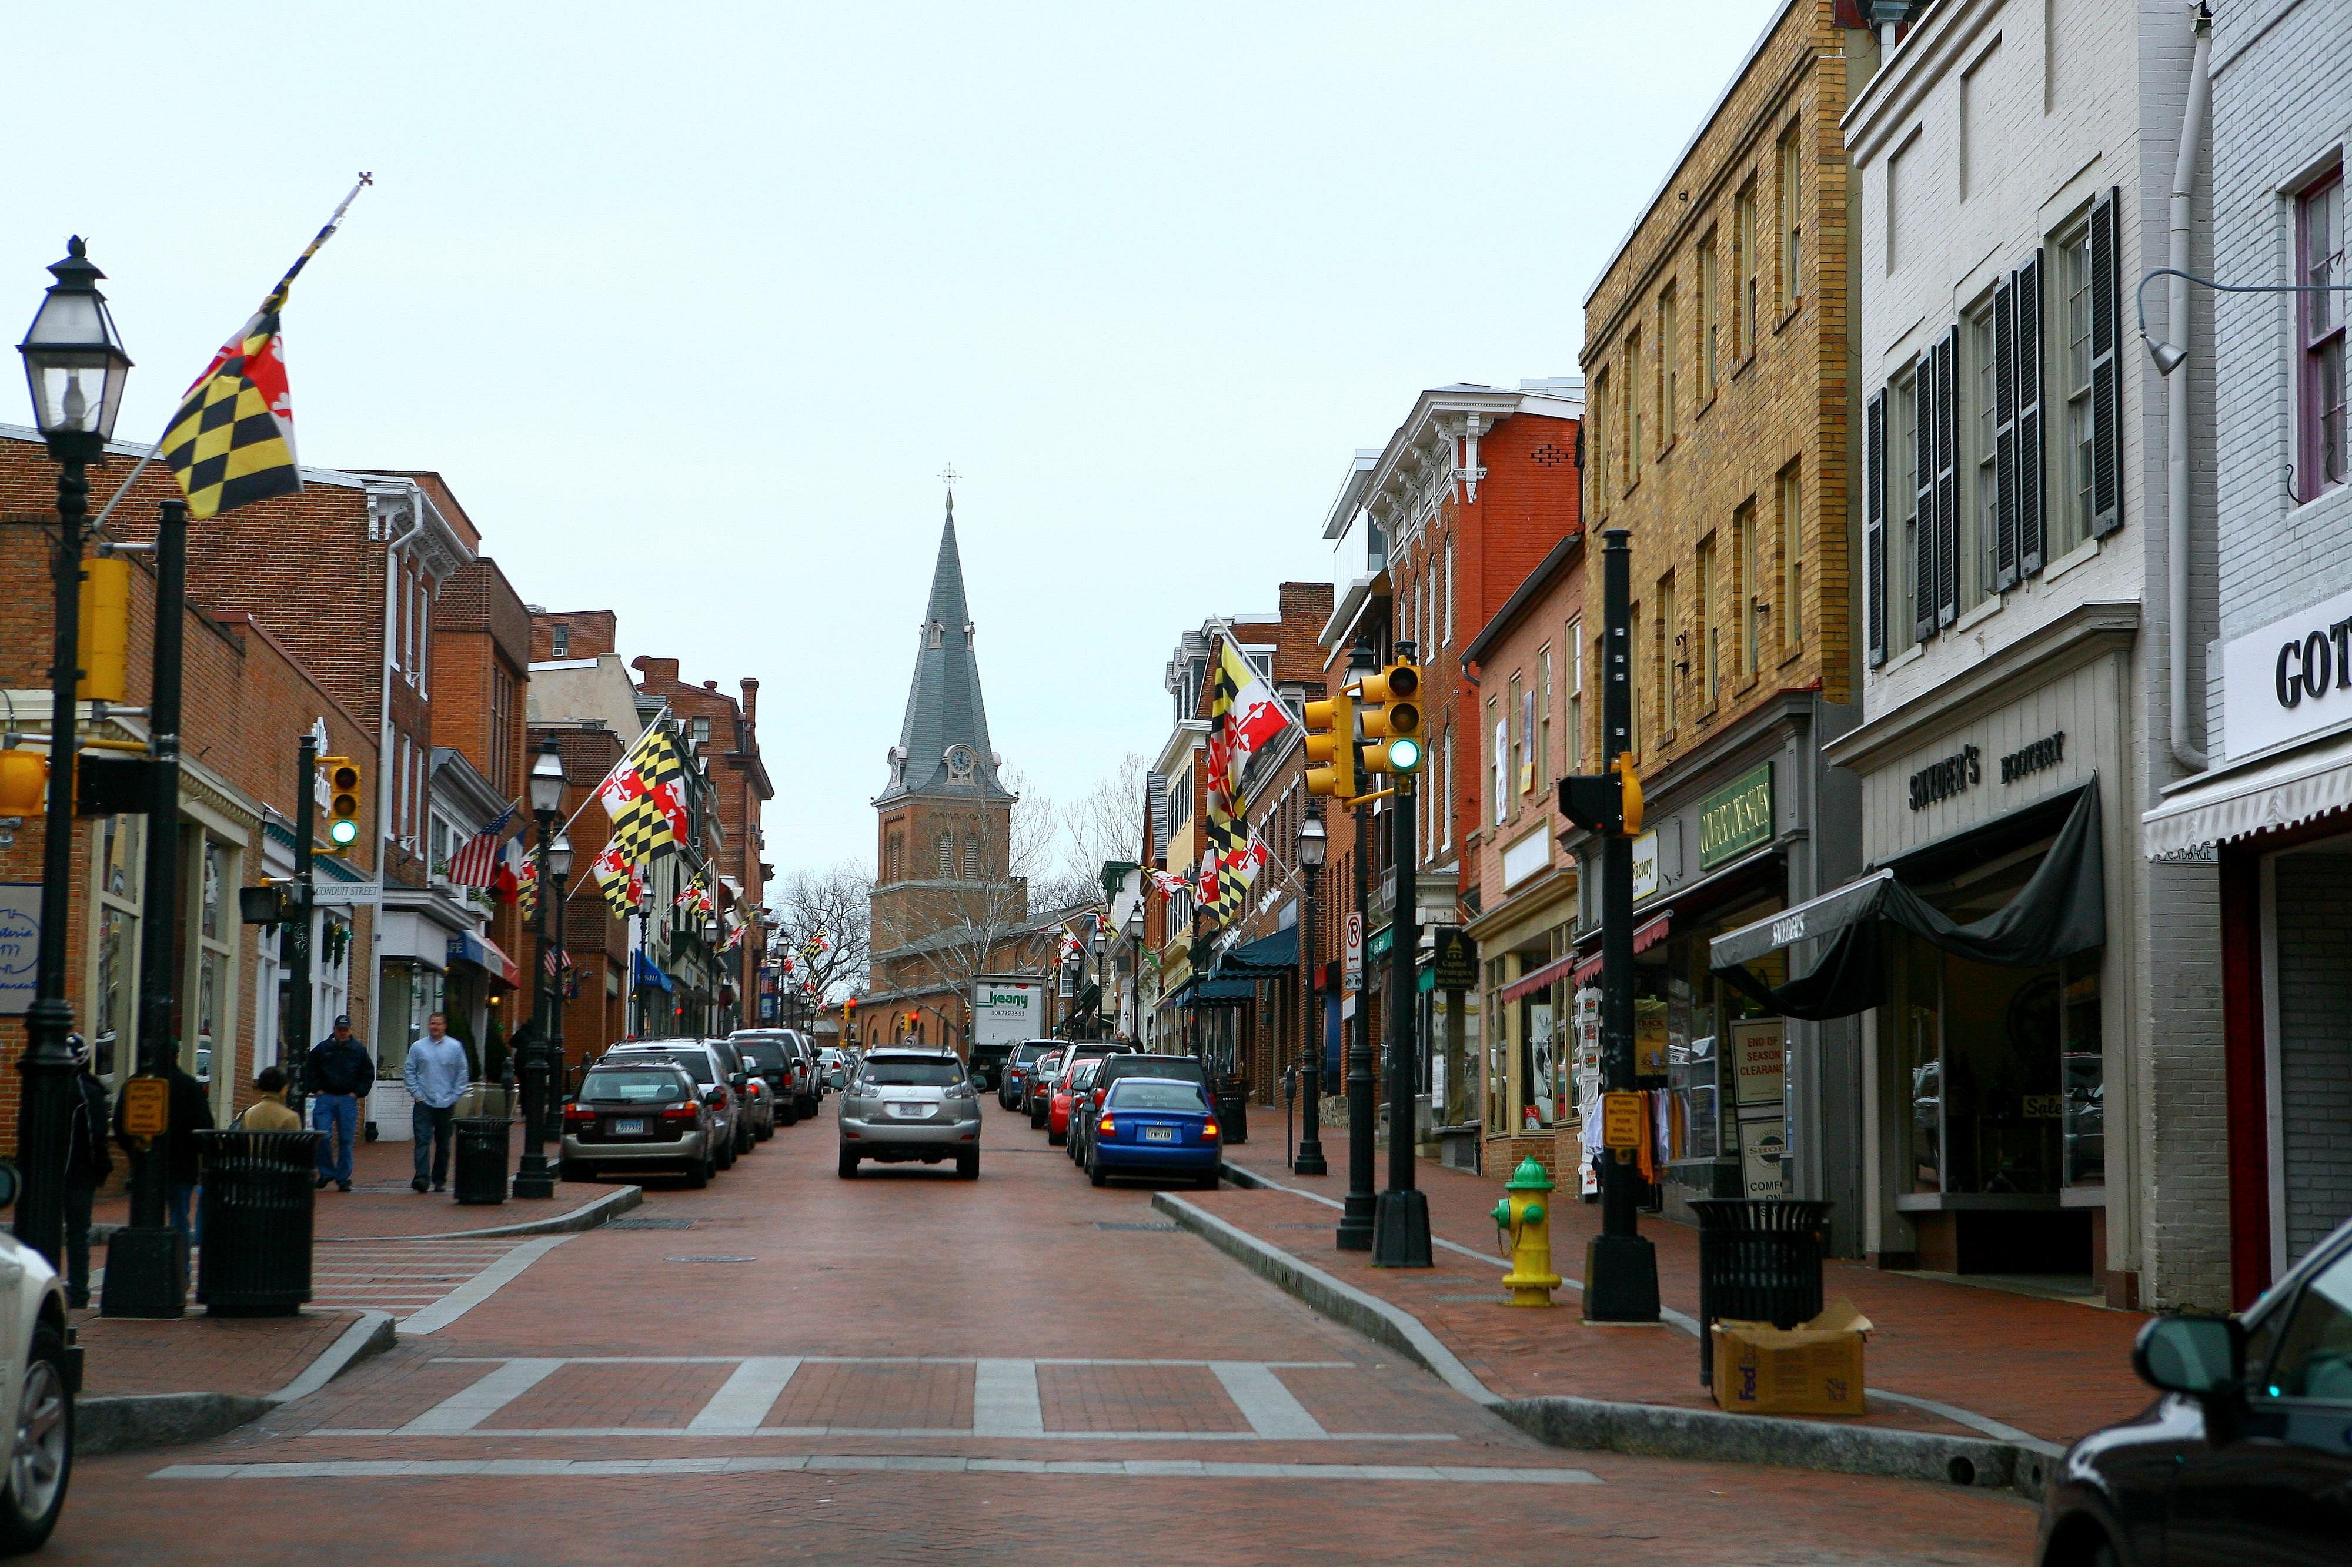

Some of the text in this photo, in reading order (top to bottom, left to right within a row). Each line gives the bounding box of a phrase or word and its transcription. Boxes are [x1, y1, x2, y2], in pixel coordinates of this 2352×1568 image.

[2276, 616, 2352, 708] GOT
[1909, 731, 2065, 810] SNYDER'S BOOTERY
[316, 885, 378, 896] CONDUIT STREET
[1772, 912, 1804, 946] SNYDER'S
[989, 991, 1028, 1009] keany
[1747, 1036, 1778, 1047] END OF
[1746, 1049, 1782, 1062] SEASON
[2026, 1097, 2062, 1115] Sale
